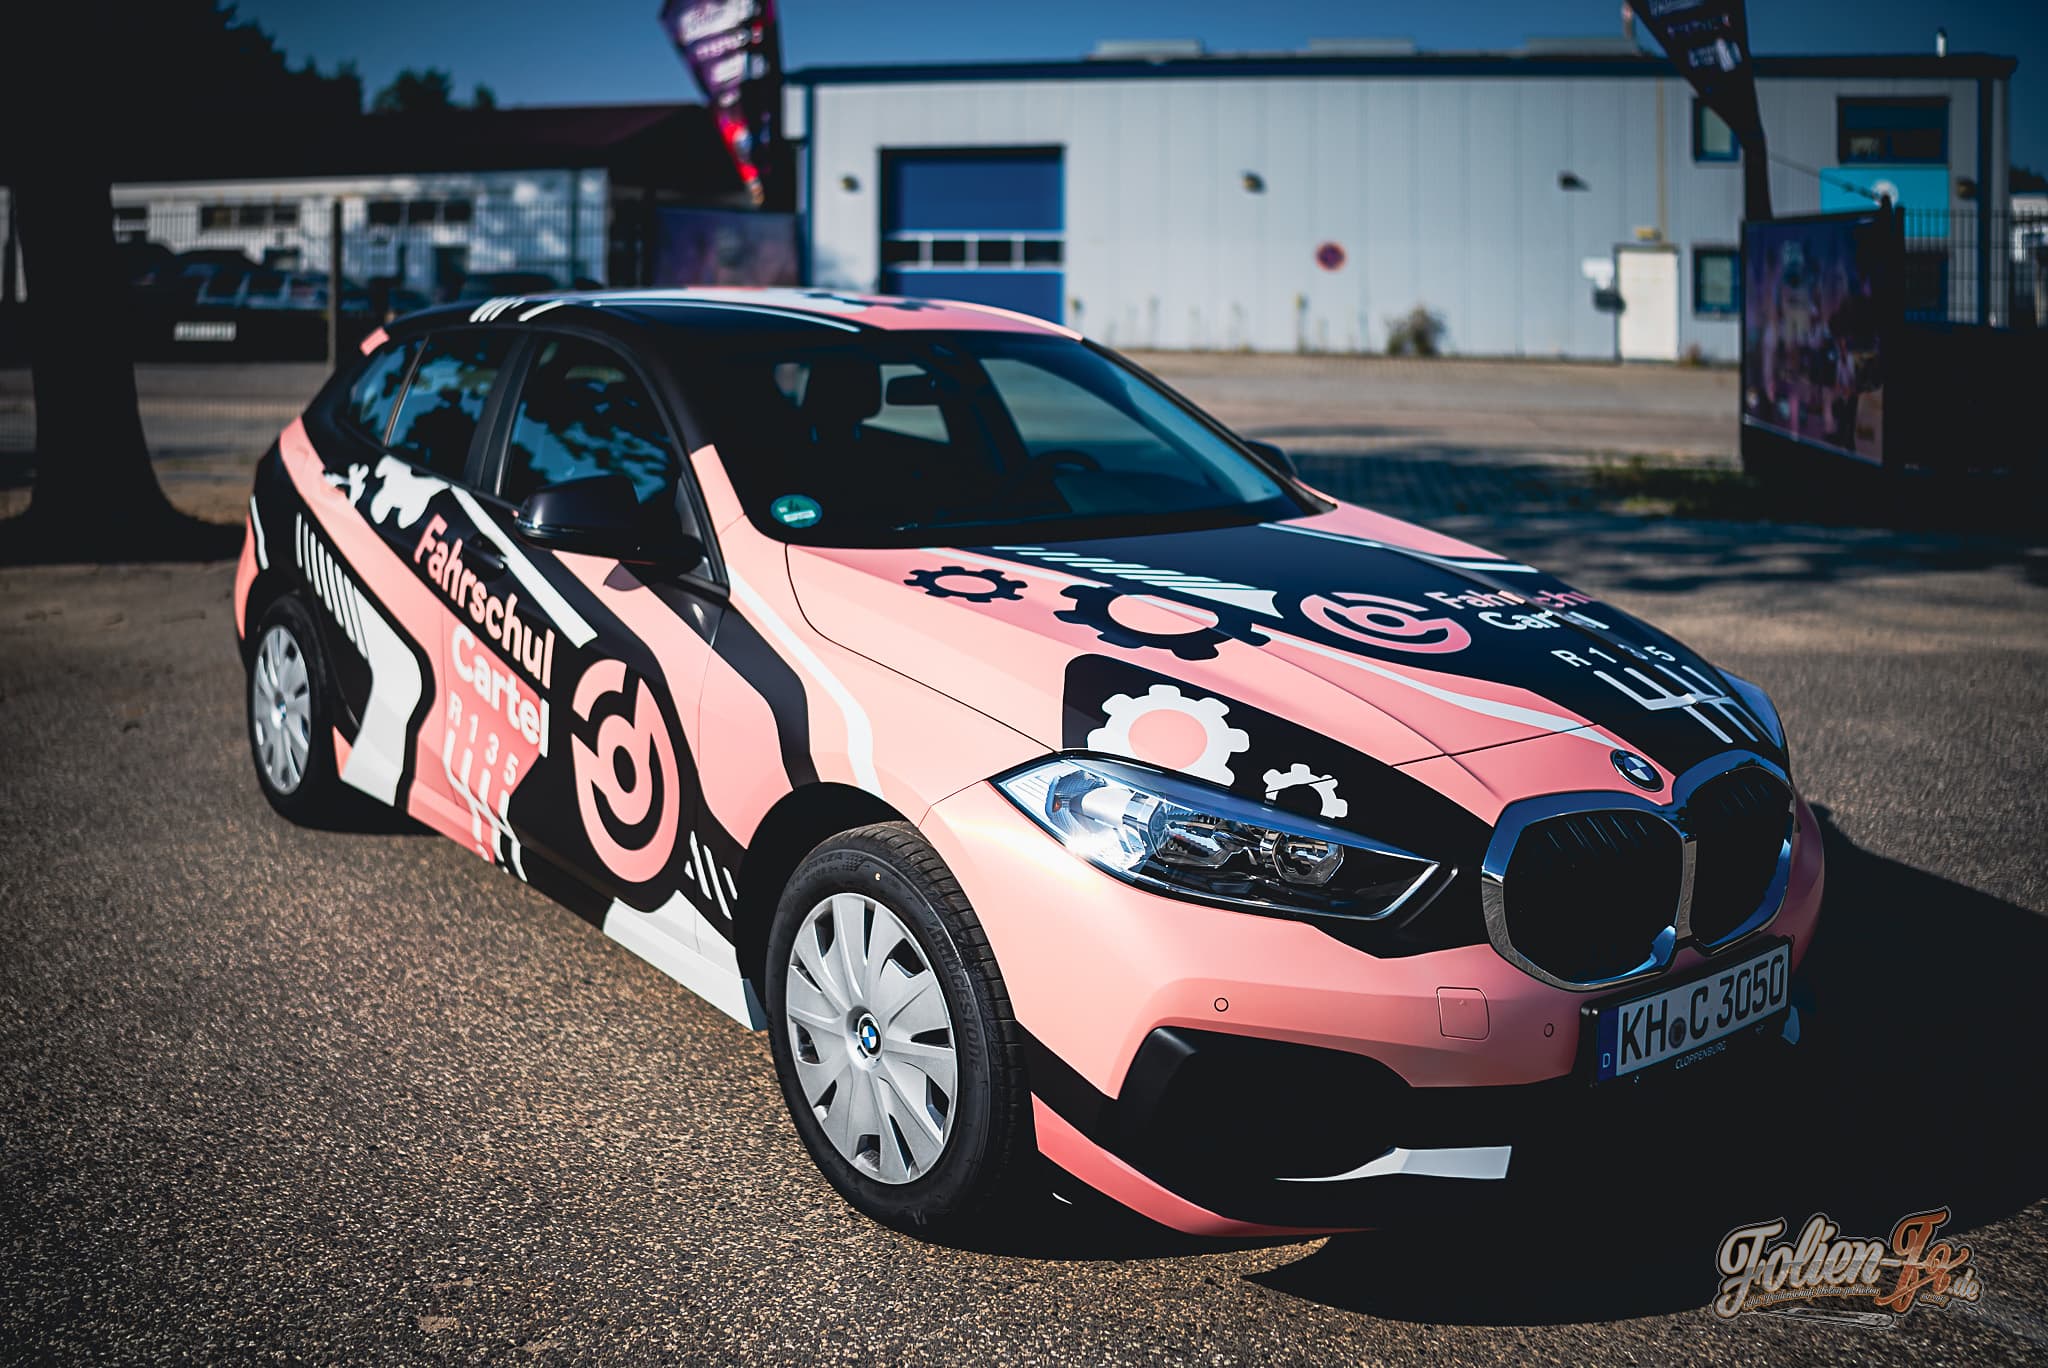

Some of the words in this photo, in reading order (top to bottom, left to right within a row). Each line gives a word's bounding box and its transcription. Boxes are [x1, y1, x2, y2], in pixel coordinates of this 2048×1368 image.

[413, 513, 555, 689] Fahrschul
[451, 624, 550, 758] Cartel
[1602, 1053, 1611, 1068] D
[1620, 999, 1668, 1066] KH
[1689, 985, 1709, 1040] C
[1716, 955, 1784, 1029] 3050
